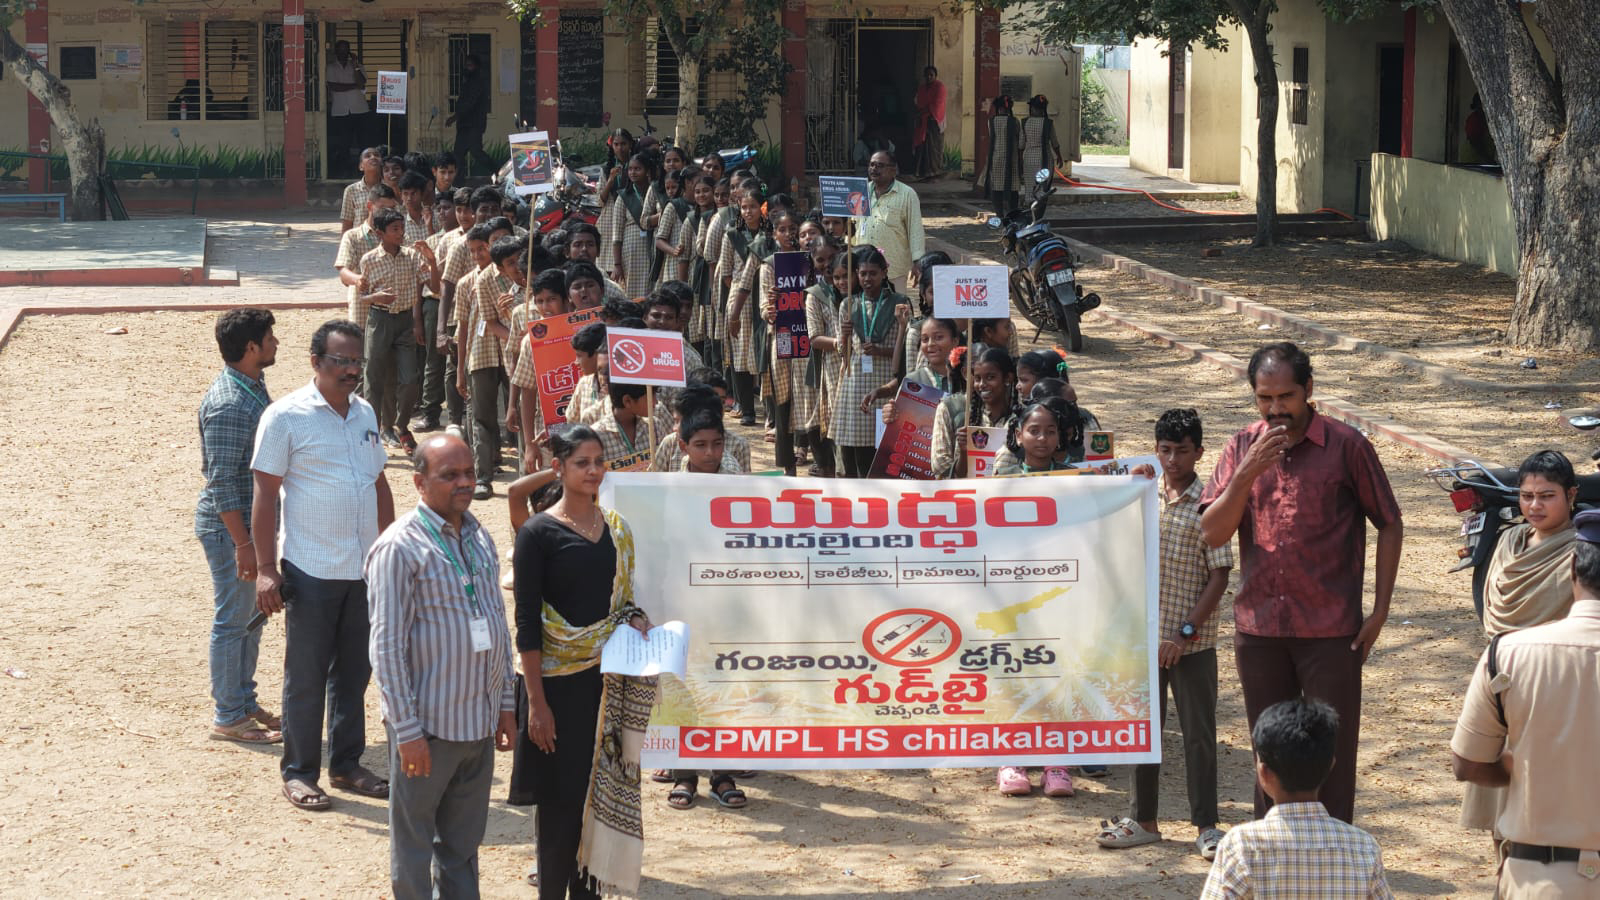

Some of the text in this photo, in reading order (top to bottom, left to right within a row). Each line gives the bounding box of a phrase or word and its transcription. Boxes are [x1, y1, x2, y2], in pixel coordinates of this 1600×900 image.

[777, 276, 797, 288] SAY
[799, 274, 807, 287] N
[791, 336, 810, 356] 19
[652, 357, 681, 367] DRUGS
[660, 351, 673, 359] NO
[724, 532, 914, 556] మొదలైంది
[643, 738, 677, 750] SHRI
[684, 722, 1147, 754] CPMPL HS chilakalapudi
